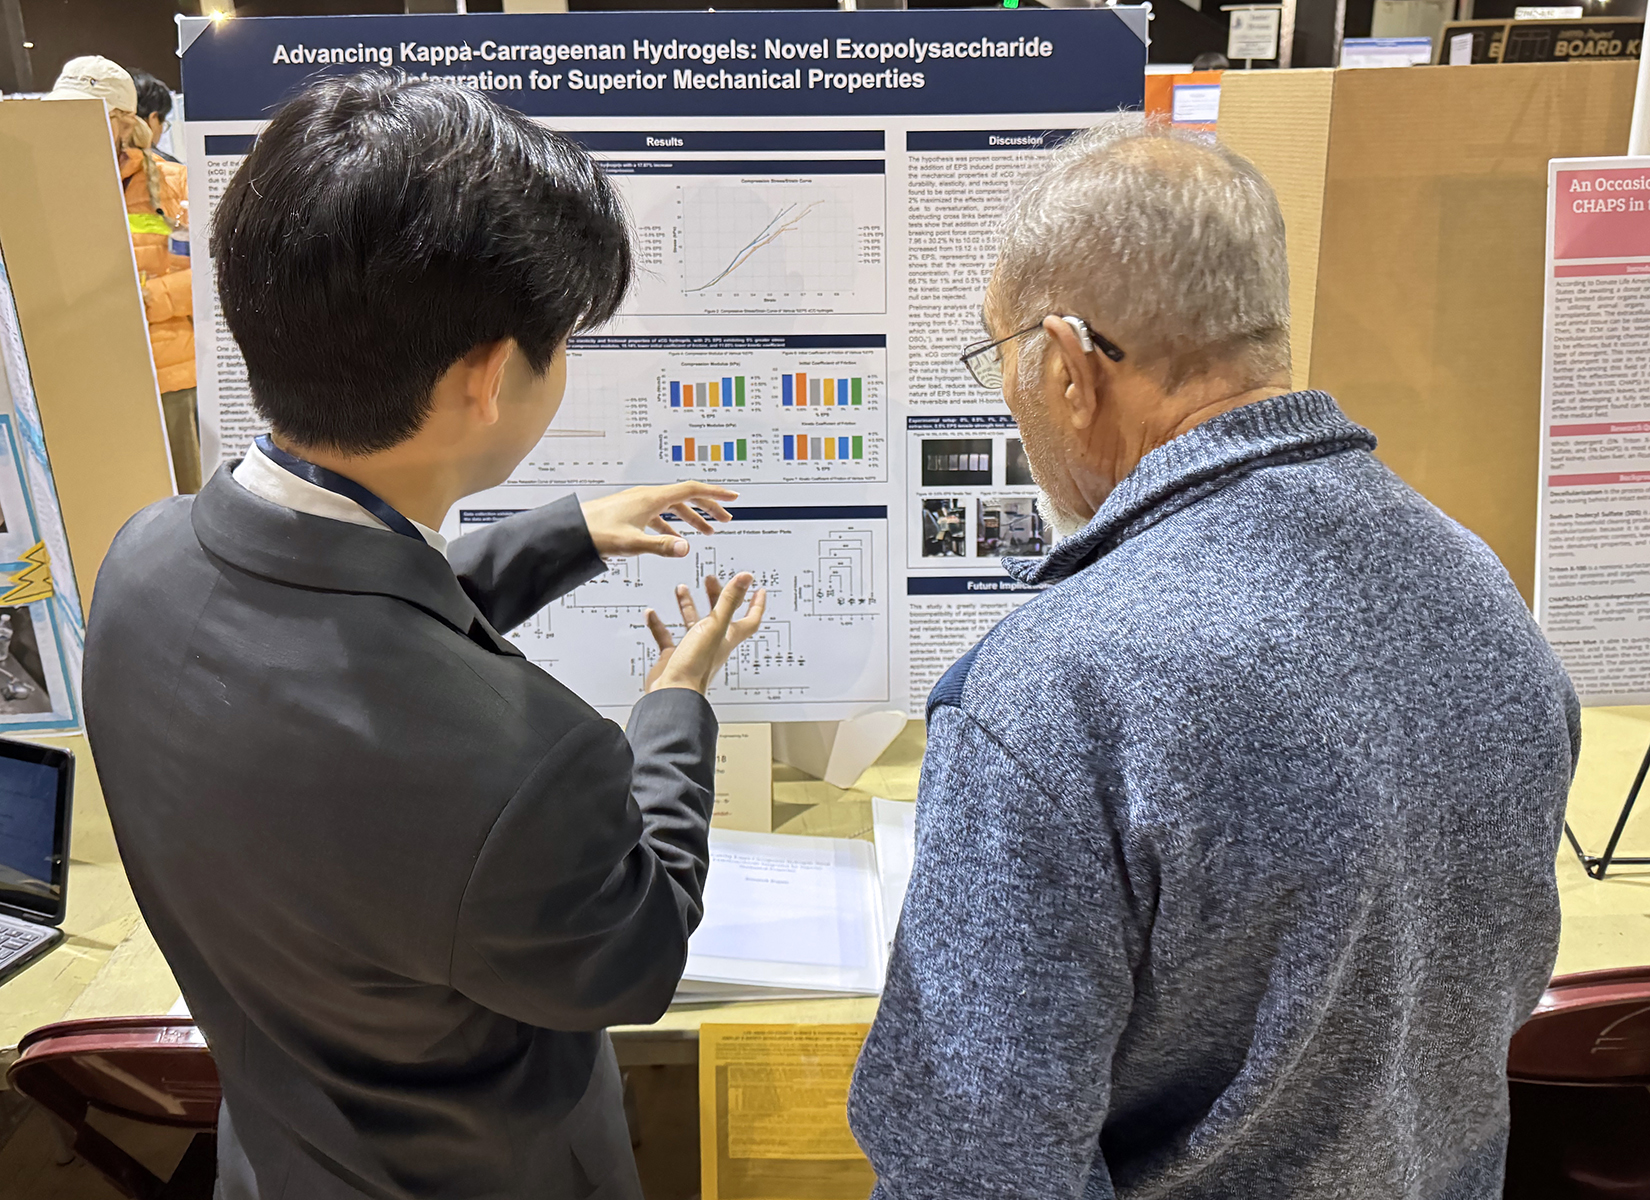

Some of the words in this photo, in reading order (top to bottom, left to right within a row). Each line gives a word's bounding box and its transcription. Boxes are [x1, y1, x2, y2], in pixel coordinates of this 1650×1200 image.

[273, 44, 393, 67] Advancing
[400, 40, 627, 62] Kappa-Carrageenan
[633, 39, 756, 64] Hydrogels:
[765, 39, 829, 59] Novel
[836, 37, 1053, 62] Exopolysaccharide
[1554, 40, 1621, 56] BOARD
[1627, 40, 1640, 54] K
[529, 70, 562, 90] for
[567, 69, 665, 94] Superior
[673, 69, 801, 90] Mechanical
[808, 68, 926, 94] Properties
[646, 137, 683, 146] Results
[989, 135, 1043, 146] Discussion
[1569, 179, 1592, 192] An
[1572, 198, 1625, 213] CHAPS
[1629, 197, 1644, 211] in
[967, 581, 998, 590] Future
[717, 755, 726, 763] 18
